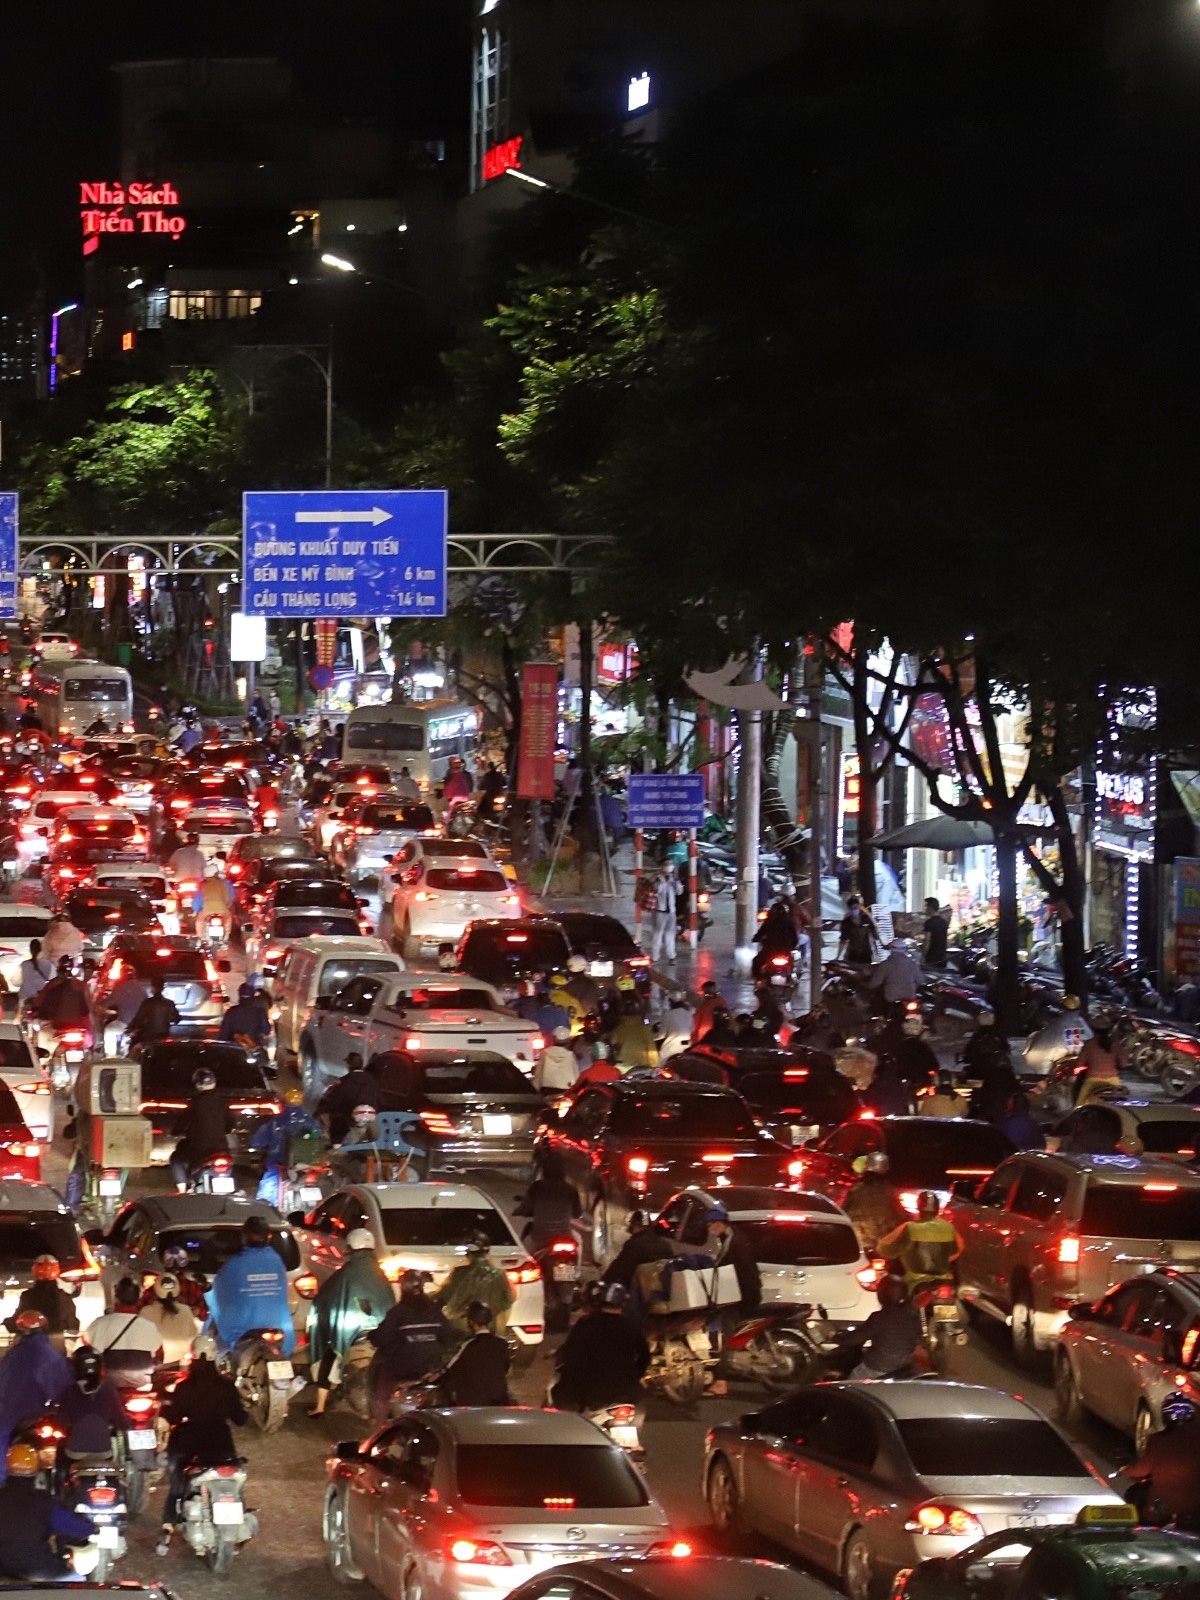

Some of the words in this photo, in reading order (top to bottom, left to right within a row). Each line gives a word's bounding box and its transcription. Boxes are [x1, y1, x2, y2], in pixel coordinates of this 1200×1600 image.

[80, 182, 125, 204] Nhà
[128, 182, 179, 205] Sách
[80, 206, 135, 233] Tiến
[136, 210, 187, 240] Thọ
[299, 536, 340, 556] KHUẤT
[343, 541, 368, 556] DUY
[371, 535, 400, 556] TIẾN
[253, 562, 278, 582] BẾN
[282, 567, 298, 582] XE
[301, 564, 321, 581] MỸ
[324, 563, 356, 582] ĐÌNH
[404, 566, 413, 581] 6
[415, 566, 436, 581] km
[253, 588, 278, 607] CẦU
[324, 592, 358, 608] LONG
[415, 591, 436, 606] km
